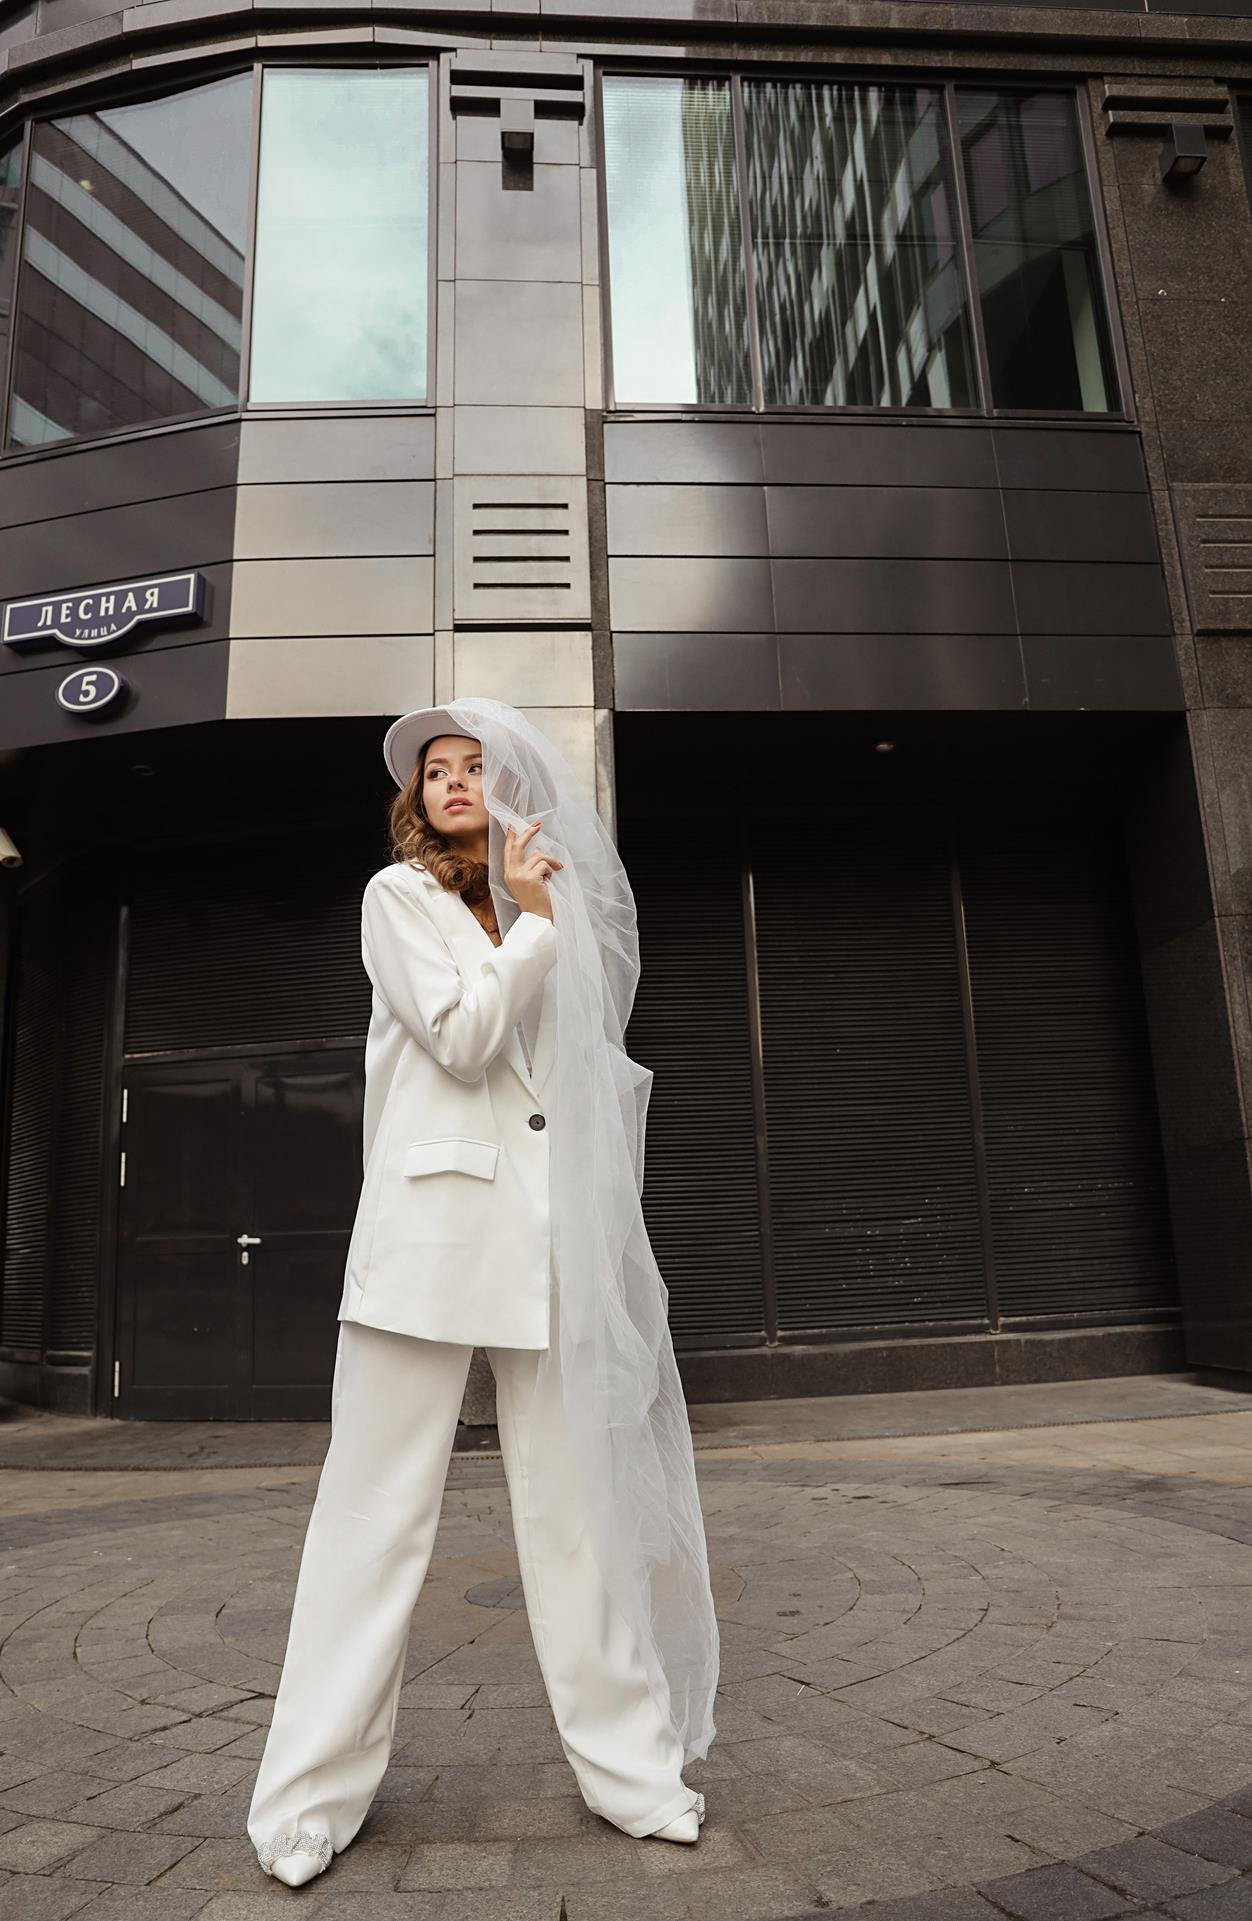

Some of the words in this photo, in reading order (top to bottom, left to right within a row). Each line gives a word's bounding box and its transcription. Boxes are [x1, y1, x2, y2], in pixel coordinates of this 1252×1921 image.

[37, 587, 160, 627] ЛЕСНАЯ
[74, 623, 118, 639] УЛИЦА
[78, 674, 98, 702] 5
